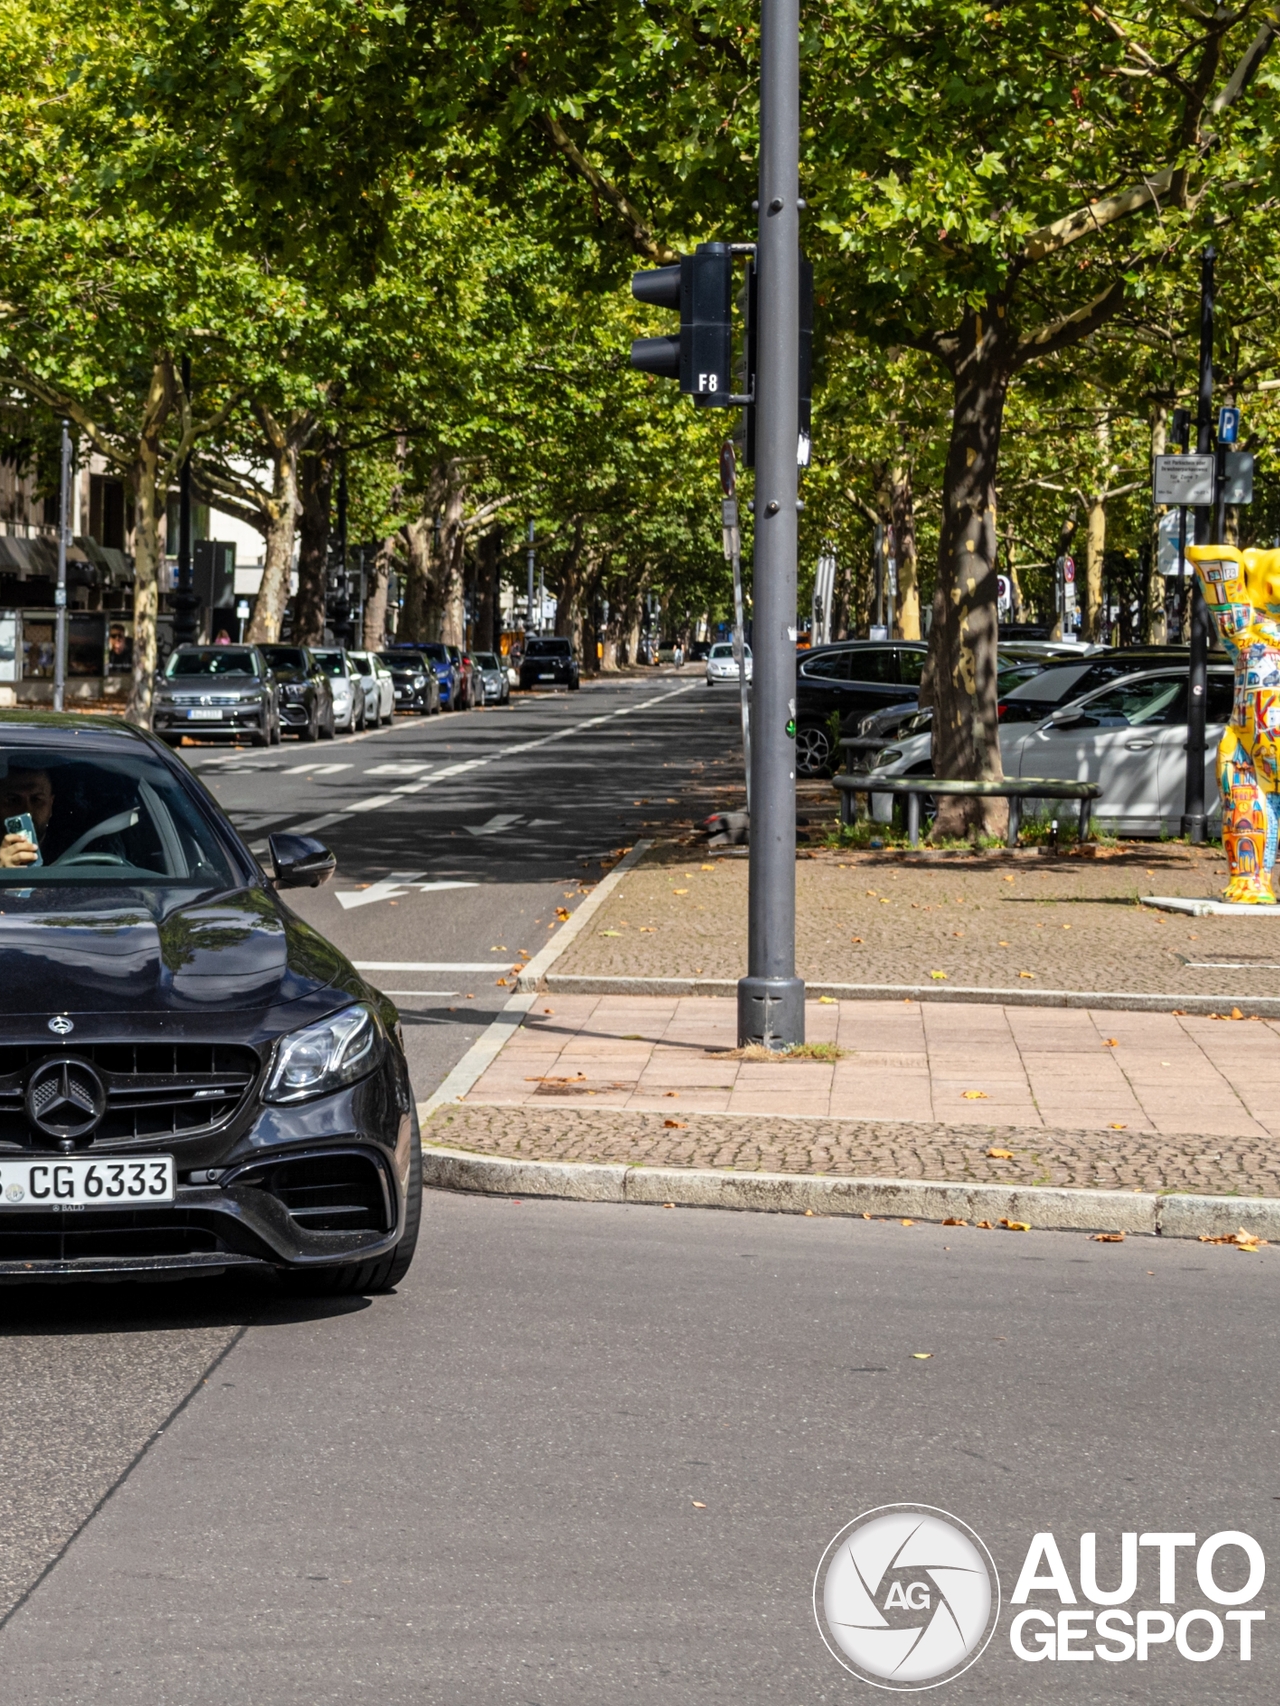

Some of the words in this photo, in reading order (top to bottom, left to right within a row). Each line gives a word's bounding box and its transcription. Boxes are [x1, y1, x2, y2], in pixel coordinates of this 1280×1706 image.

[699, 373, 718, 392] F8
[1223, 412, 1234, 438] P
[30, 1166, 74, 1198] CG
[84, 1163, 167, 1198] 6333
[62, 1204, 85, 1212] BALD
